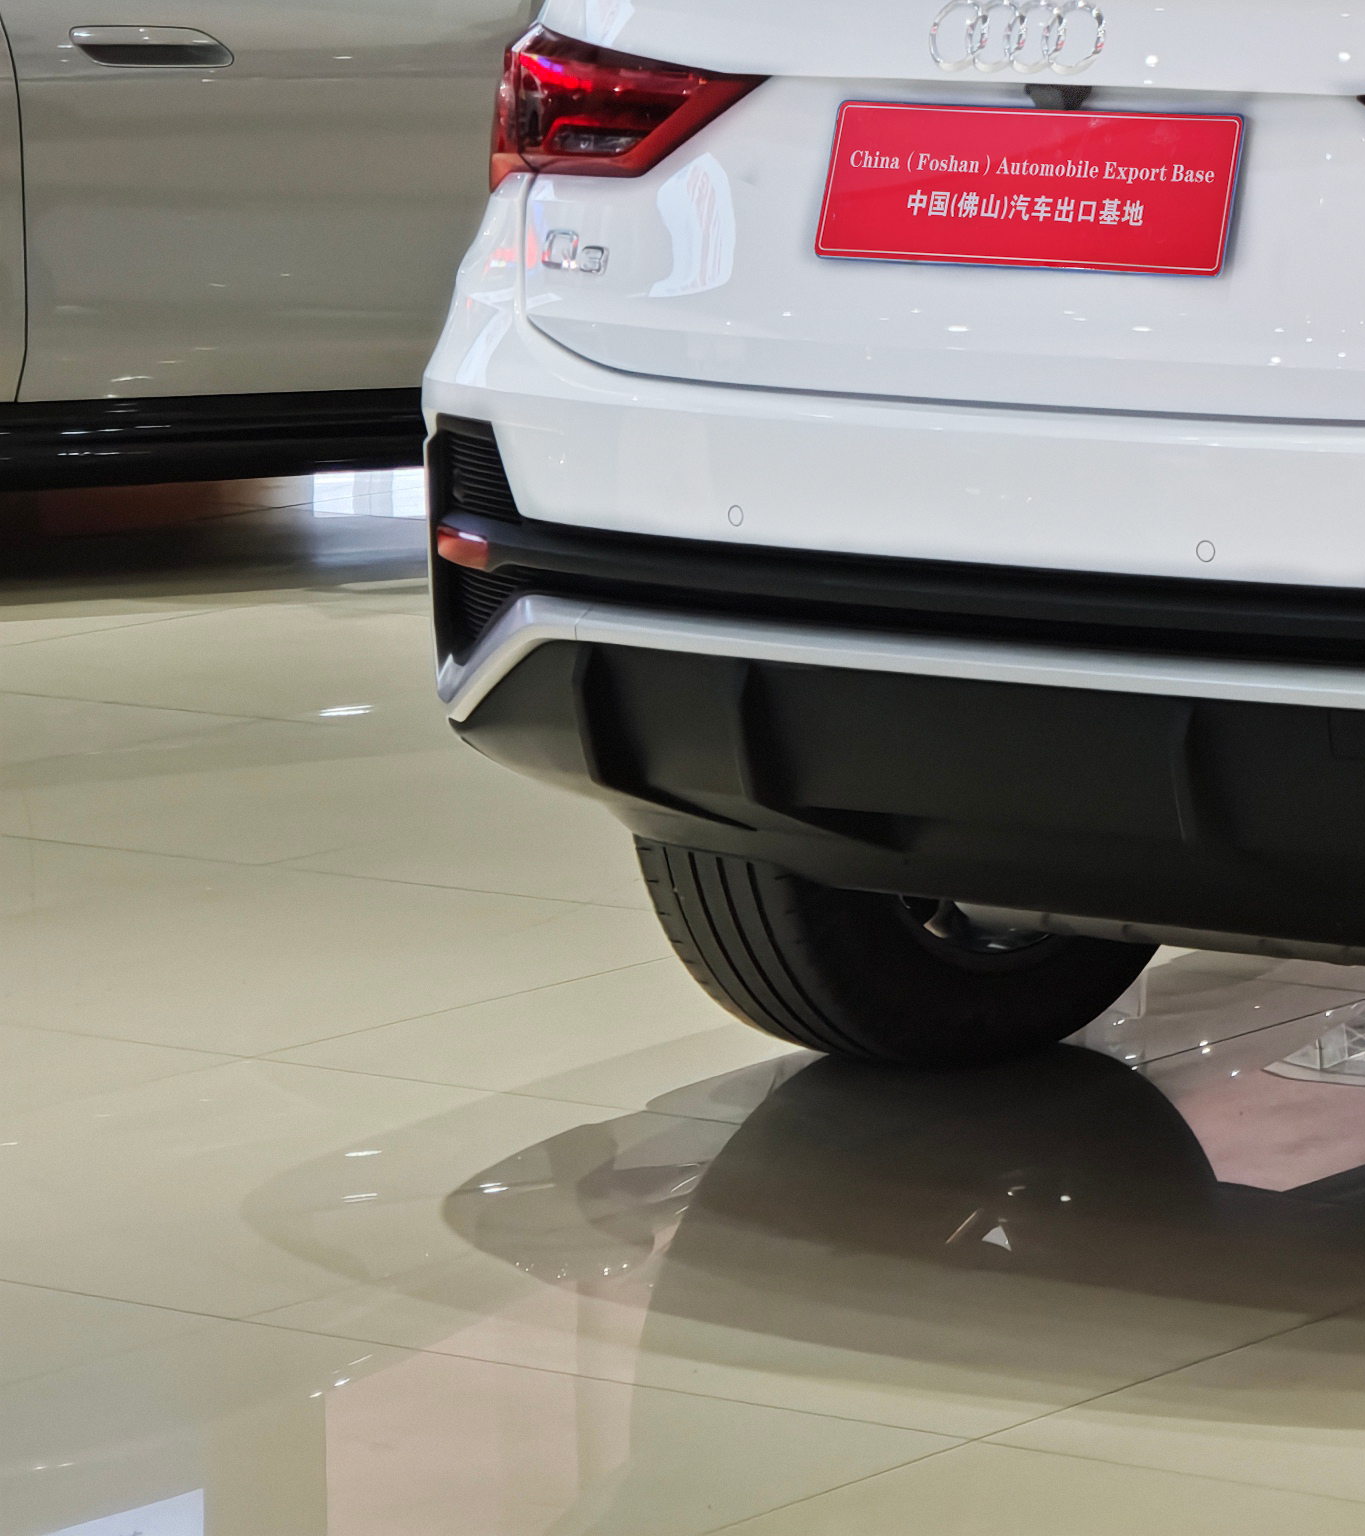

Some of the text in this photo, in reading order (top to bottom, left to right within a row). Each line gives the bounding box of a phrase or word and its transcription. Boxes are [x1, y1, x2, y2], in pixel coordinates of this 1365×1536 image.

[850, 149, 900, 170] China
[996, 156, 1100, 179] Automobile
[1103, 160, 1168, 185] Export
[1171, 163, 1215, 184] Base
[541, 229, 610, 276] Q3
